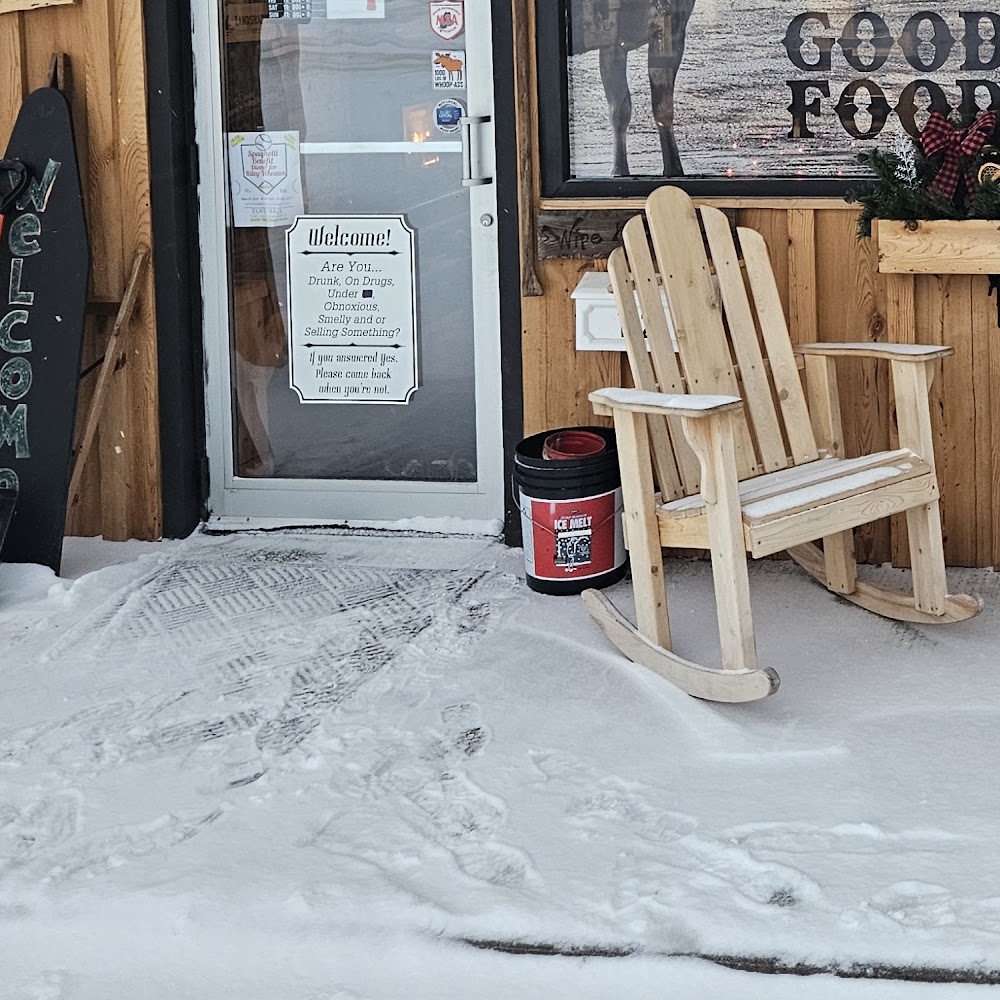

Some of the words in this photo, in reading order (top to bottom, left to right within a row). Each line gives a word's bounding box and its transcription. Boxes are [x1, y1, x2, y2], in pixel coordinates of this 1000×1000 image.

[309, 224, 391, 246] Welcome!
[558, 217, 601, 250] Wipe
[321, 261, 344, 272] Are
[348, 261, 382, 272] You...
[308, 276, 341, 286] Drunk,
[345, 277, 359, 286] On
[362, 277, 395, 287] Drugs,
[328, 289, 358, 298] Under
[324, 302, 380, 312] Obnoxious,
[318, 314, 351, 325] Smelly
[353, 315, 373, 324] and
[304, 327, 339, 338] Selling
[341, 327, 401, 339] Something?
[309, 351, 315, 366] If
[317, 354, 333, 366] you
[336, 351, 378, 363] answered
[315, 367, 343, 379] Please
[345, 370, 369, 379] come
[371, 367, 392, 379] back
[318, 382, 342, 394] when
[344, 382, 371, 397] you're
[373, 384, 390, 394] not.
[554, 519, 567, 530] ICE
[570, 516, 592, 529] MELT
